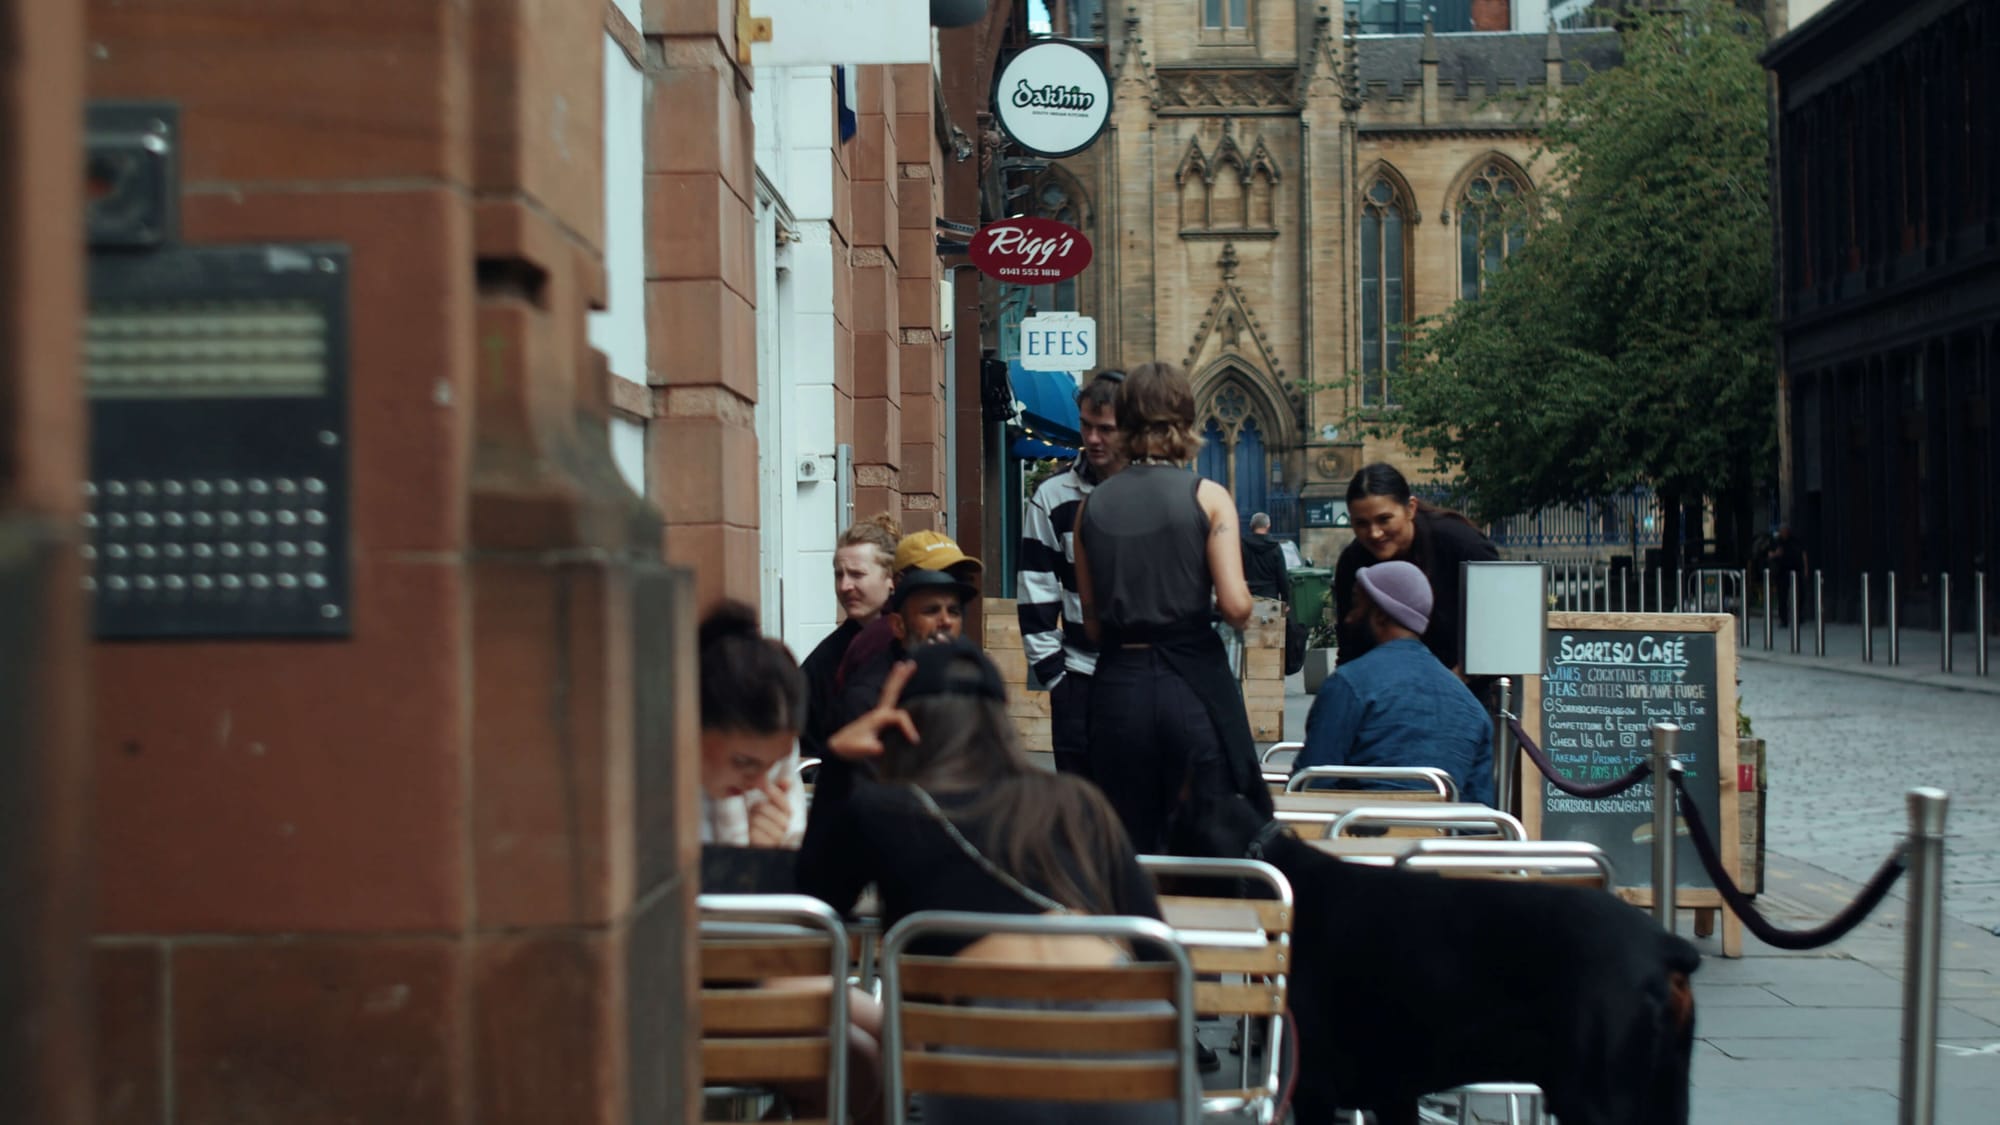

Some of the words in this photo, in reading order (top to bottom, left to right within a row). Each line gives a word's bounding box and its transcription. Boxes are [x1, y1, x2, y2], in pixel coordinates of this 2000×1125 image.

[987, 226, 1074, 265] Rigg's
[1000, 267, 1020, 276] 0141
[1022, 268, 1038, 276] 553
[1041, 268, 1060, 276] 1818
[1028, 330, 1088, 356] EFES
